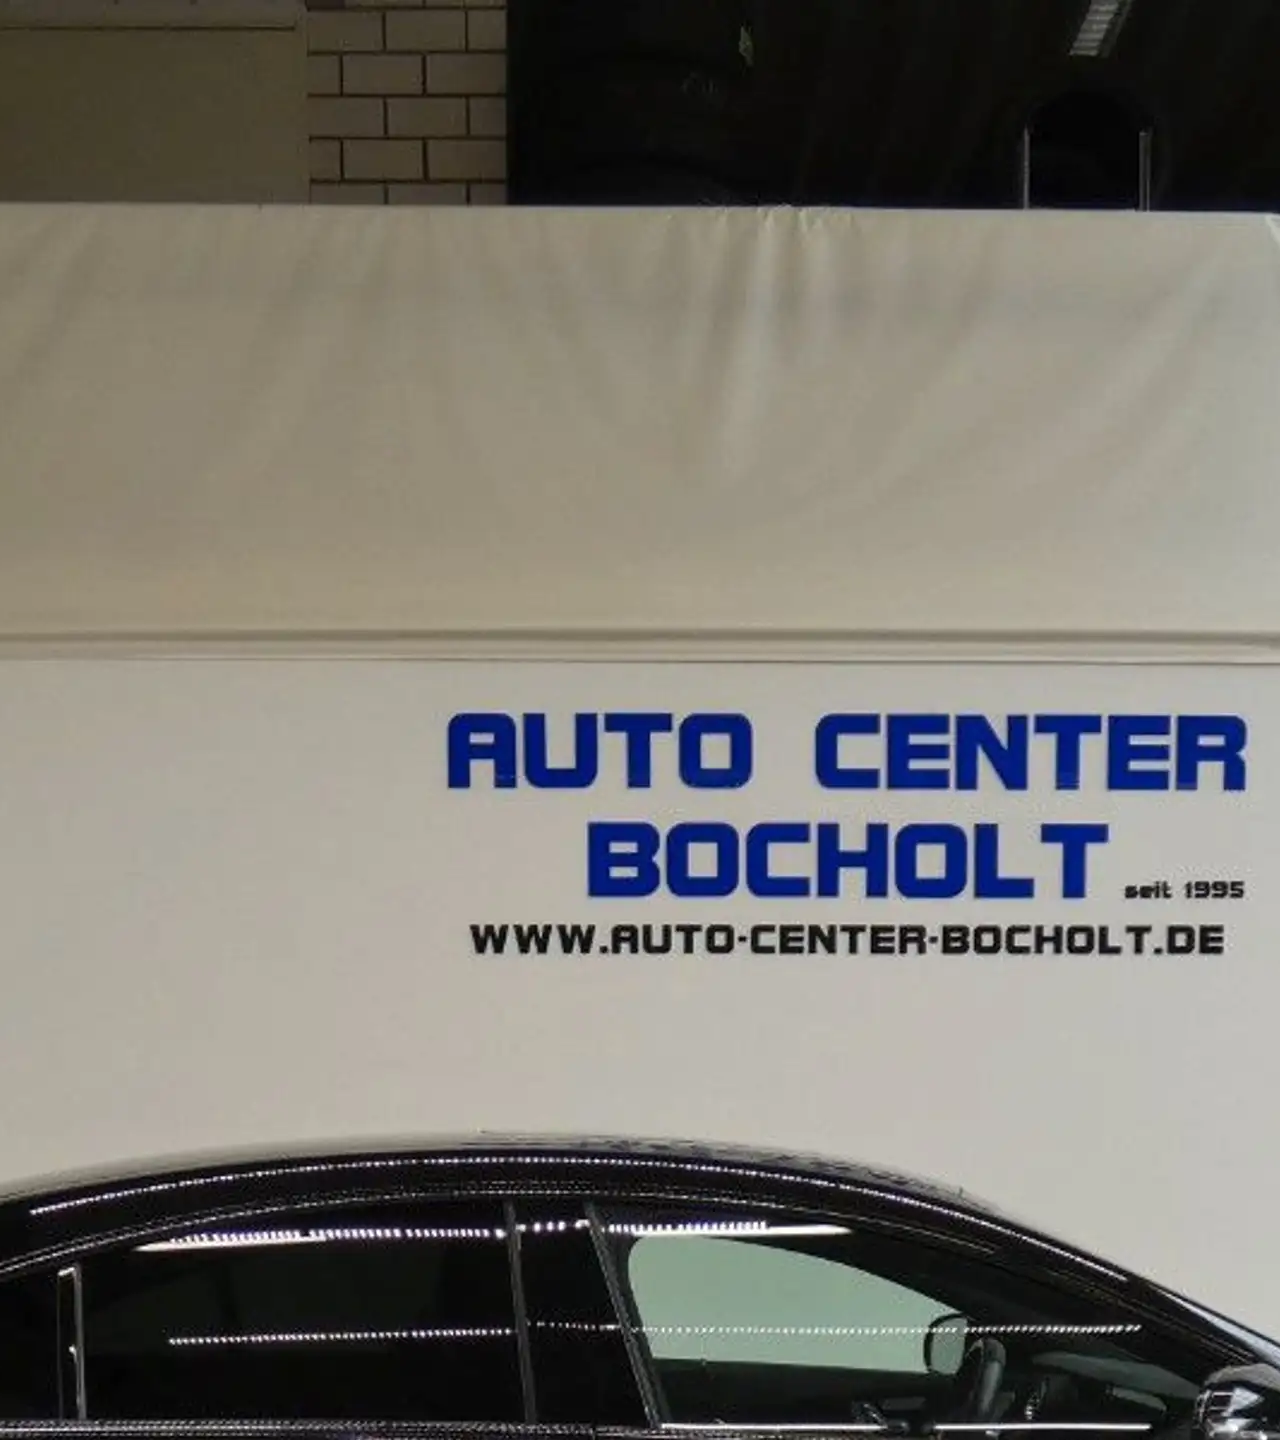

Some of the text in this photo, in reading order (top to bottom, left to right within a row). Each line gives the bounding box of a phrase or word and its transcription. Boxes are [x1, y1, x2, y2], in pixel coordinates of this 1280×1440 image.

[447, 711, 1247, 793] AUTO CENTER
[587, 821, 1245, 901] BOCHOLT seit 1995
[469, 923, 1225, 955] WWW.AUTO-CENTER-BOCHOLT.DE
